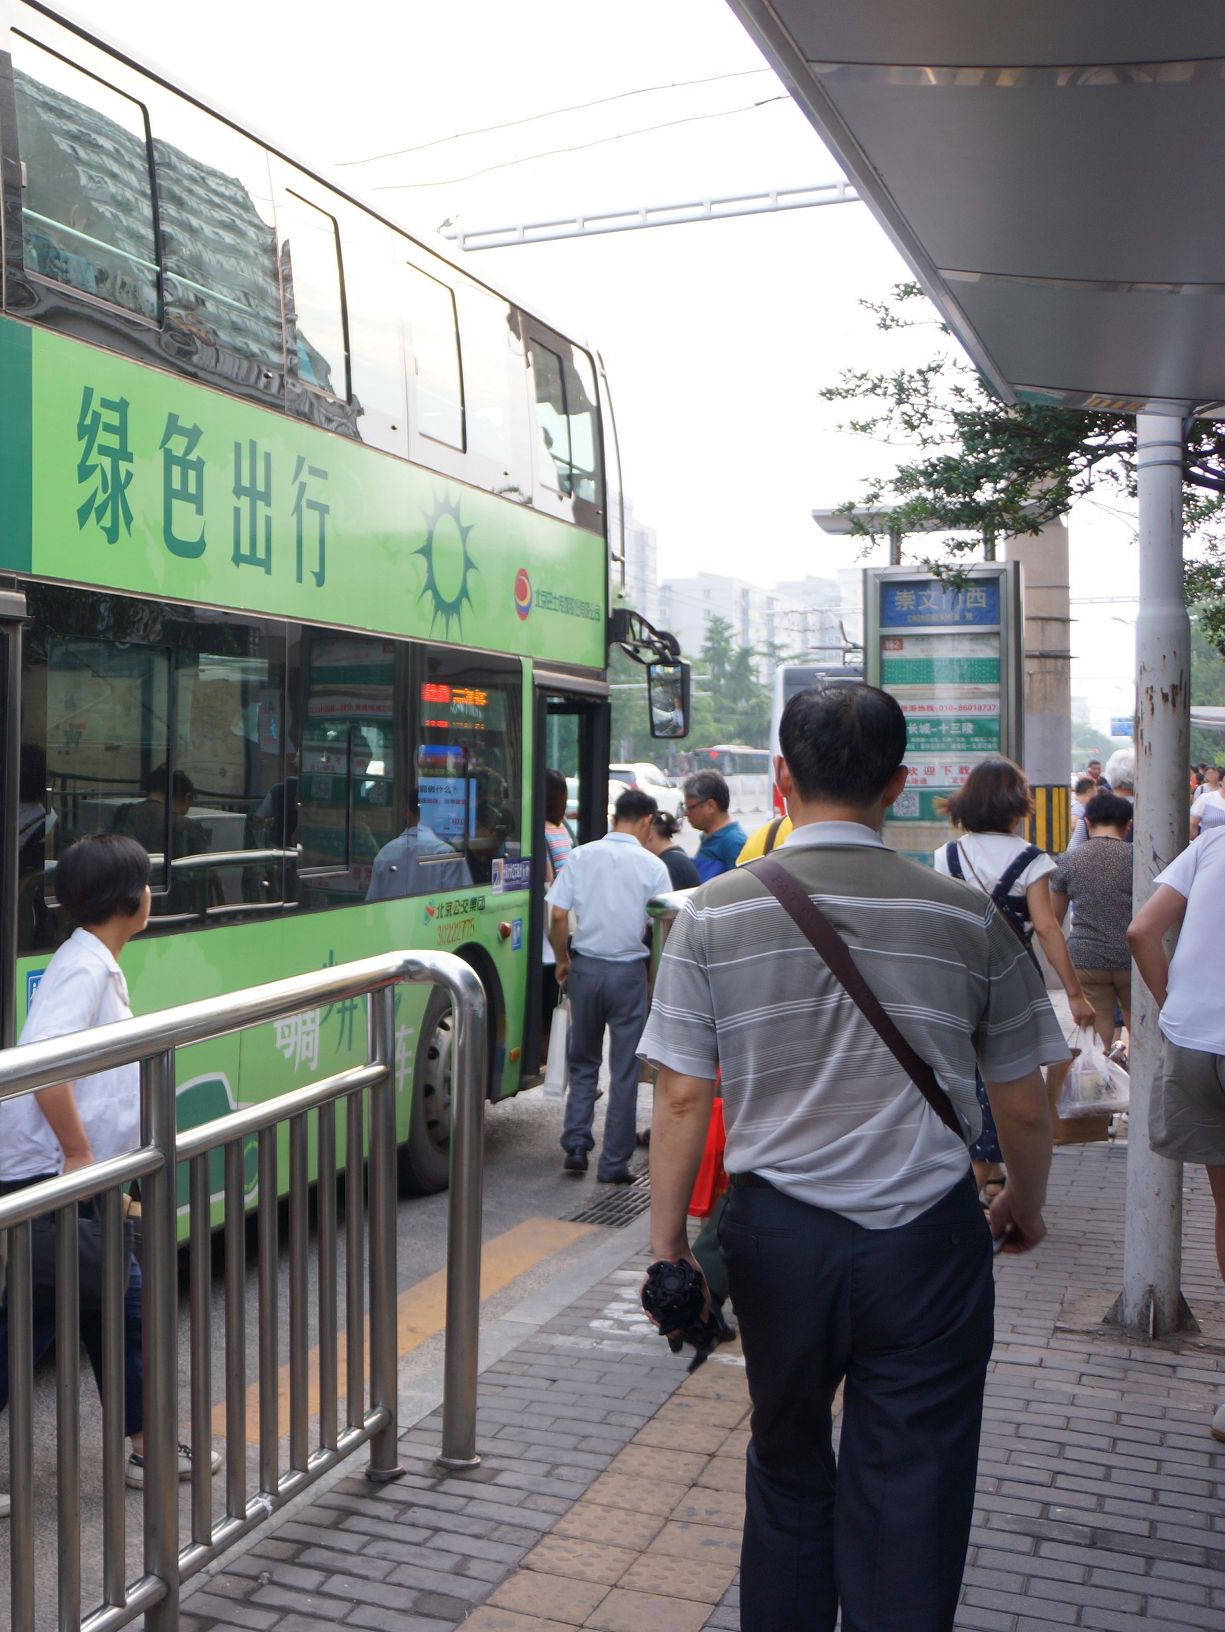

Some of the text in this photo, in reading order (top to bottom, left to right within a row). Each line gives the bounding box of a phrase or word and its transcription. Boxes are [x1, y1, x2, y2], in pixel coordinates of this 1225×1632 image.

[76, 385, 330, 588] 绿色出行
[436, 895, 486, 919] 北京公交集团
